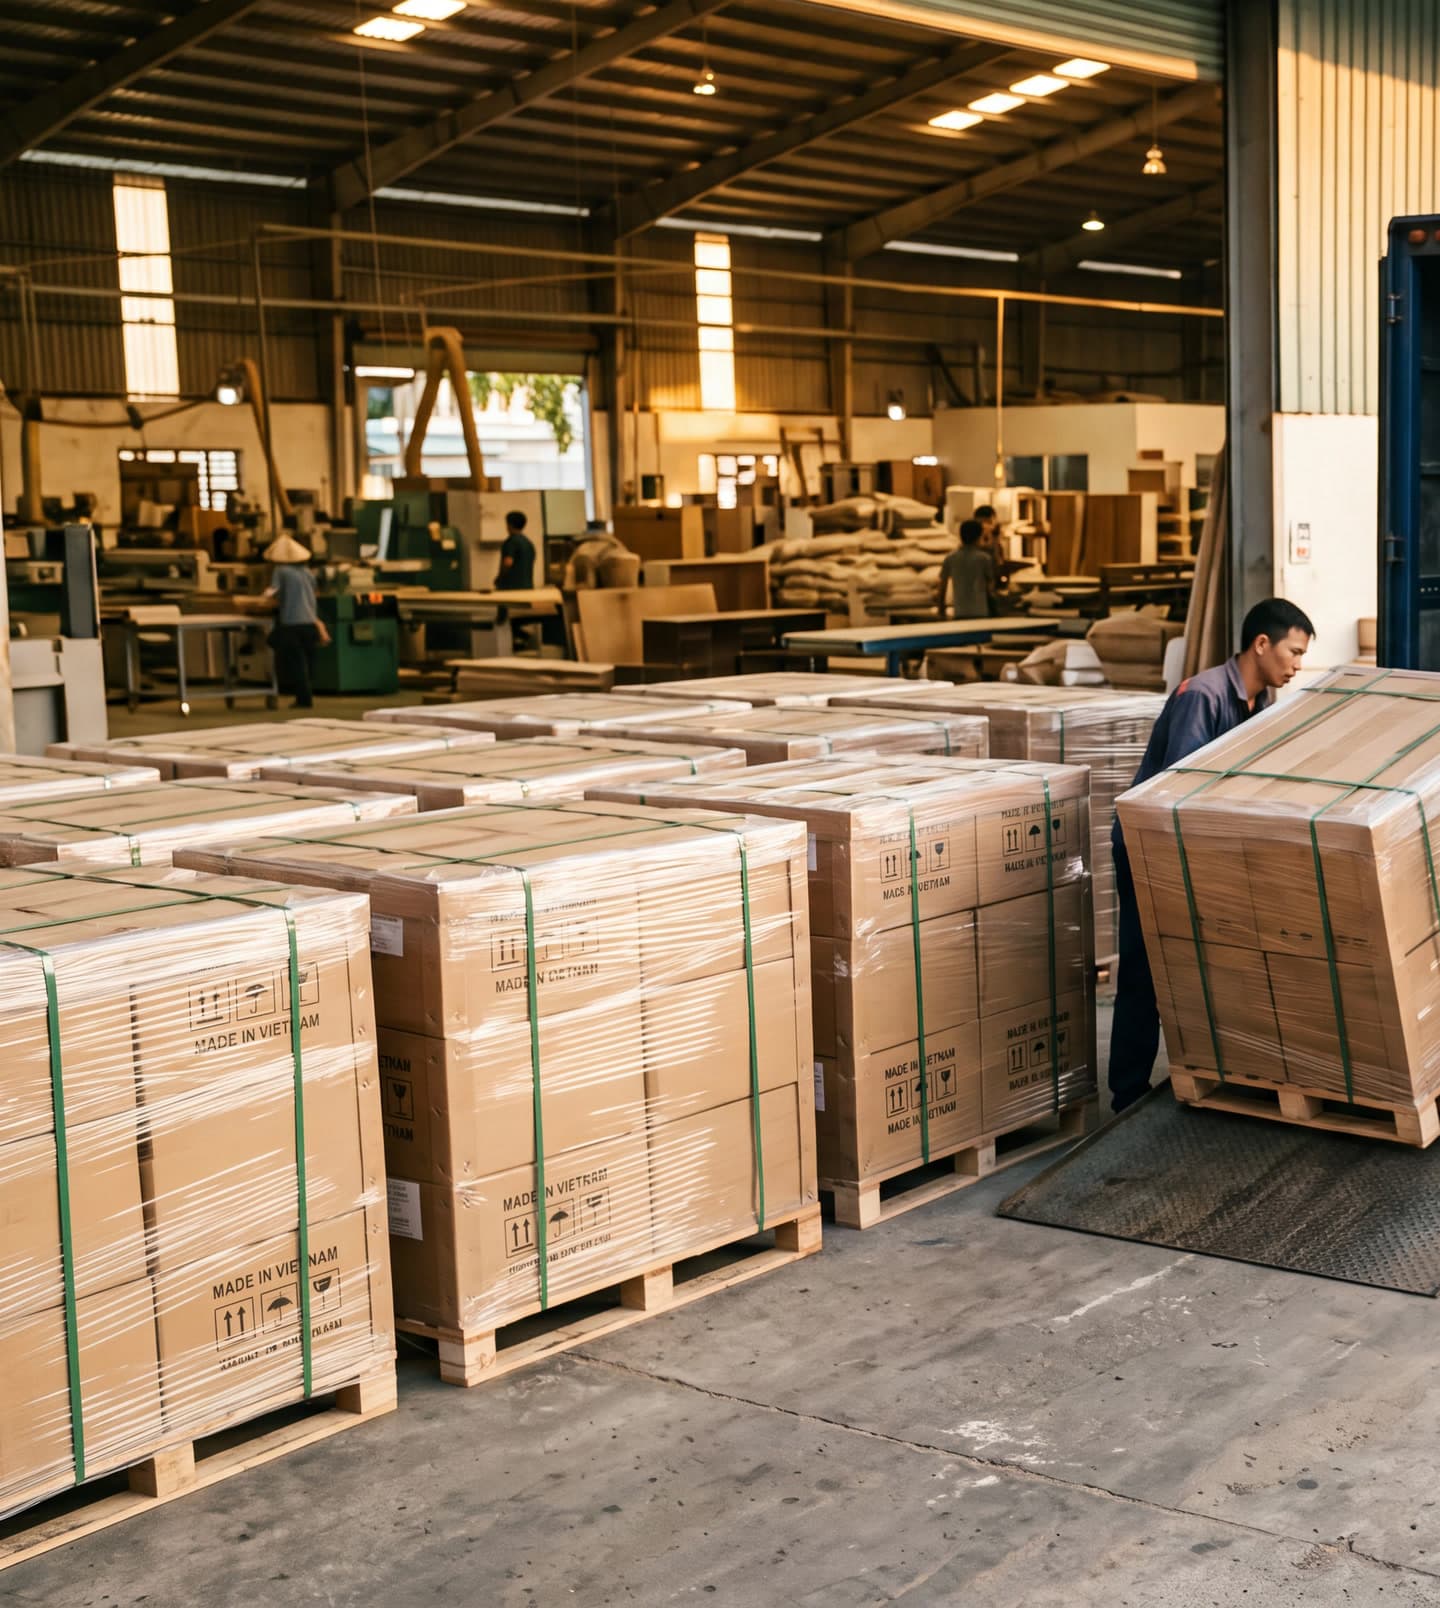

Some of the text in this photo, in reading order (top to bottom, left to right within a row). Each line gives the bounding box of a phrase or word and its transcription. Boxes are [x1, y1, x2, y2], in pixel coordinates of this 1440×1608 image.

[195, 1013, 320, 1055] MADE IN VIETAM
[503, 1190, 539, 1212] MADE
[212, 1246, 338, 1300] MADE IN VIENAM
